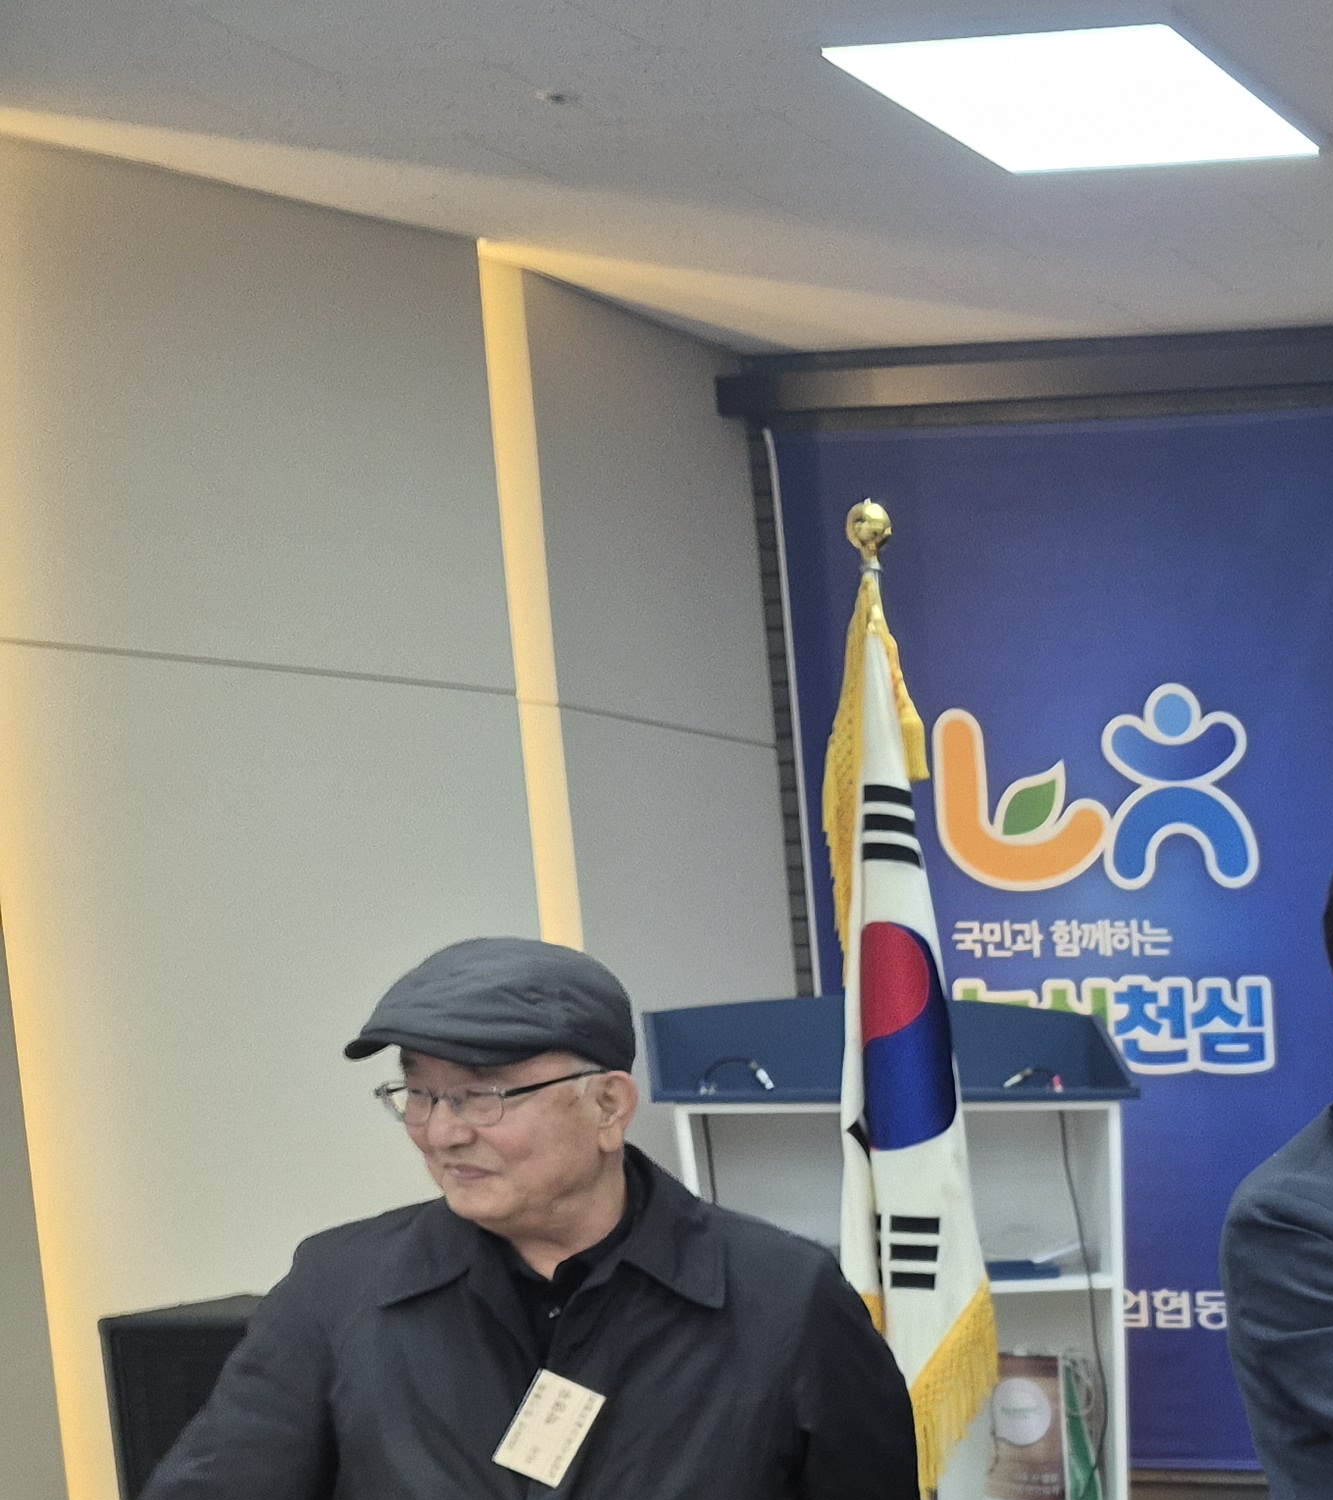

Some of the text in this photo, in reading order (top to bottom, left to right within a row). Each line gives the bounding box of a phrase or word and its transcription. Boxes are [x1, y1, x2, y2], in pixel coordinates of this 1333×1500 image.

[952, 918, 1173, 959] 국민과 함께하는
[953, 975, 1275, 1075] 천심
